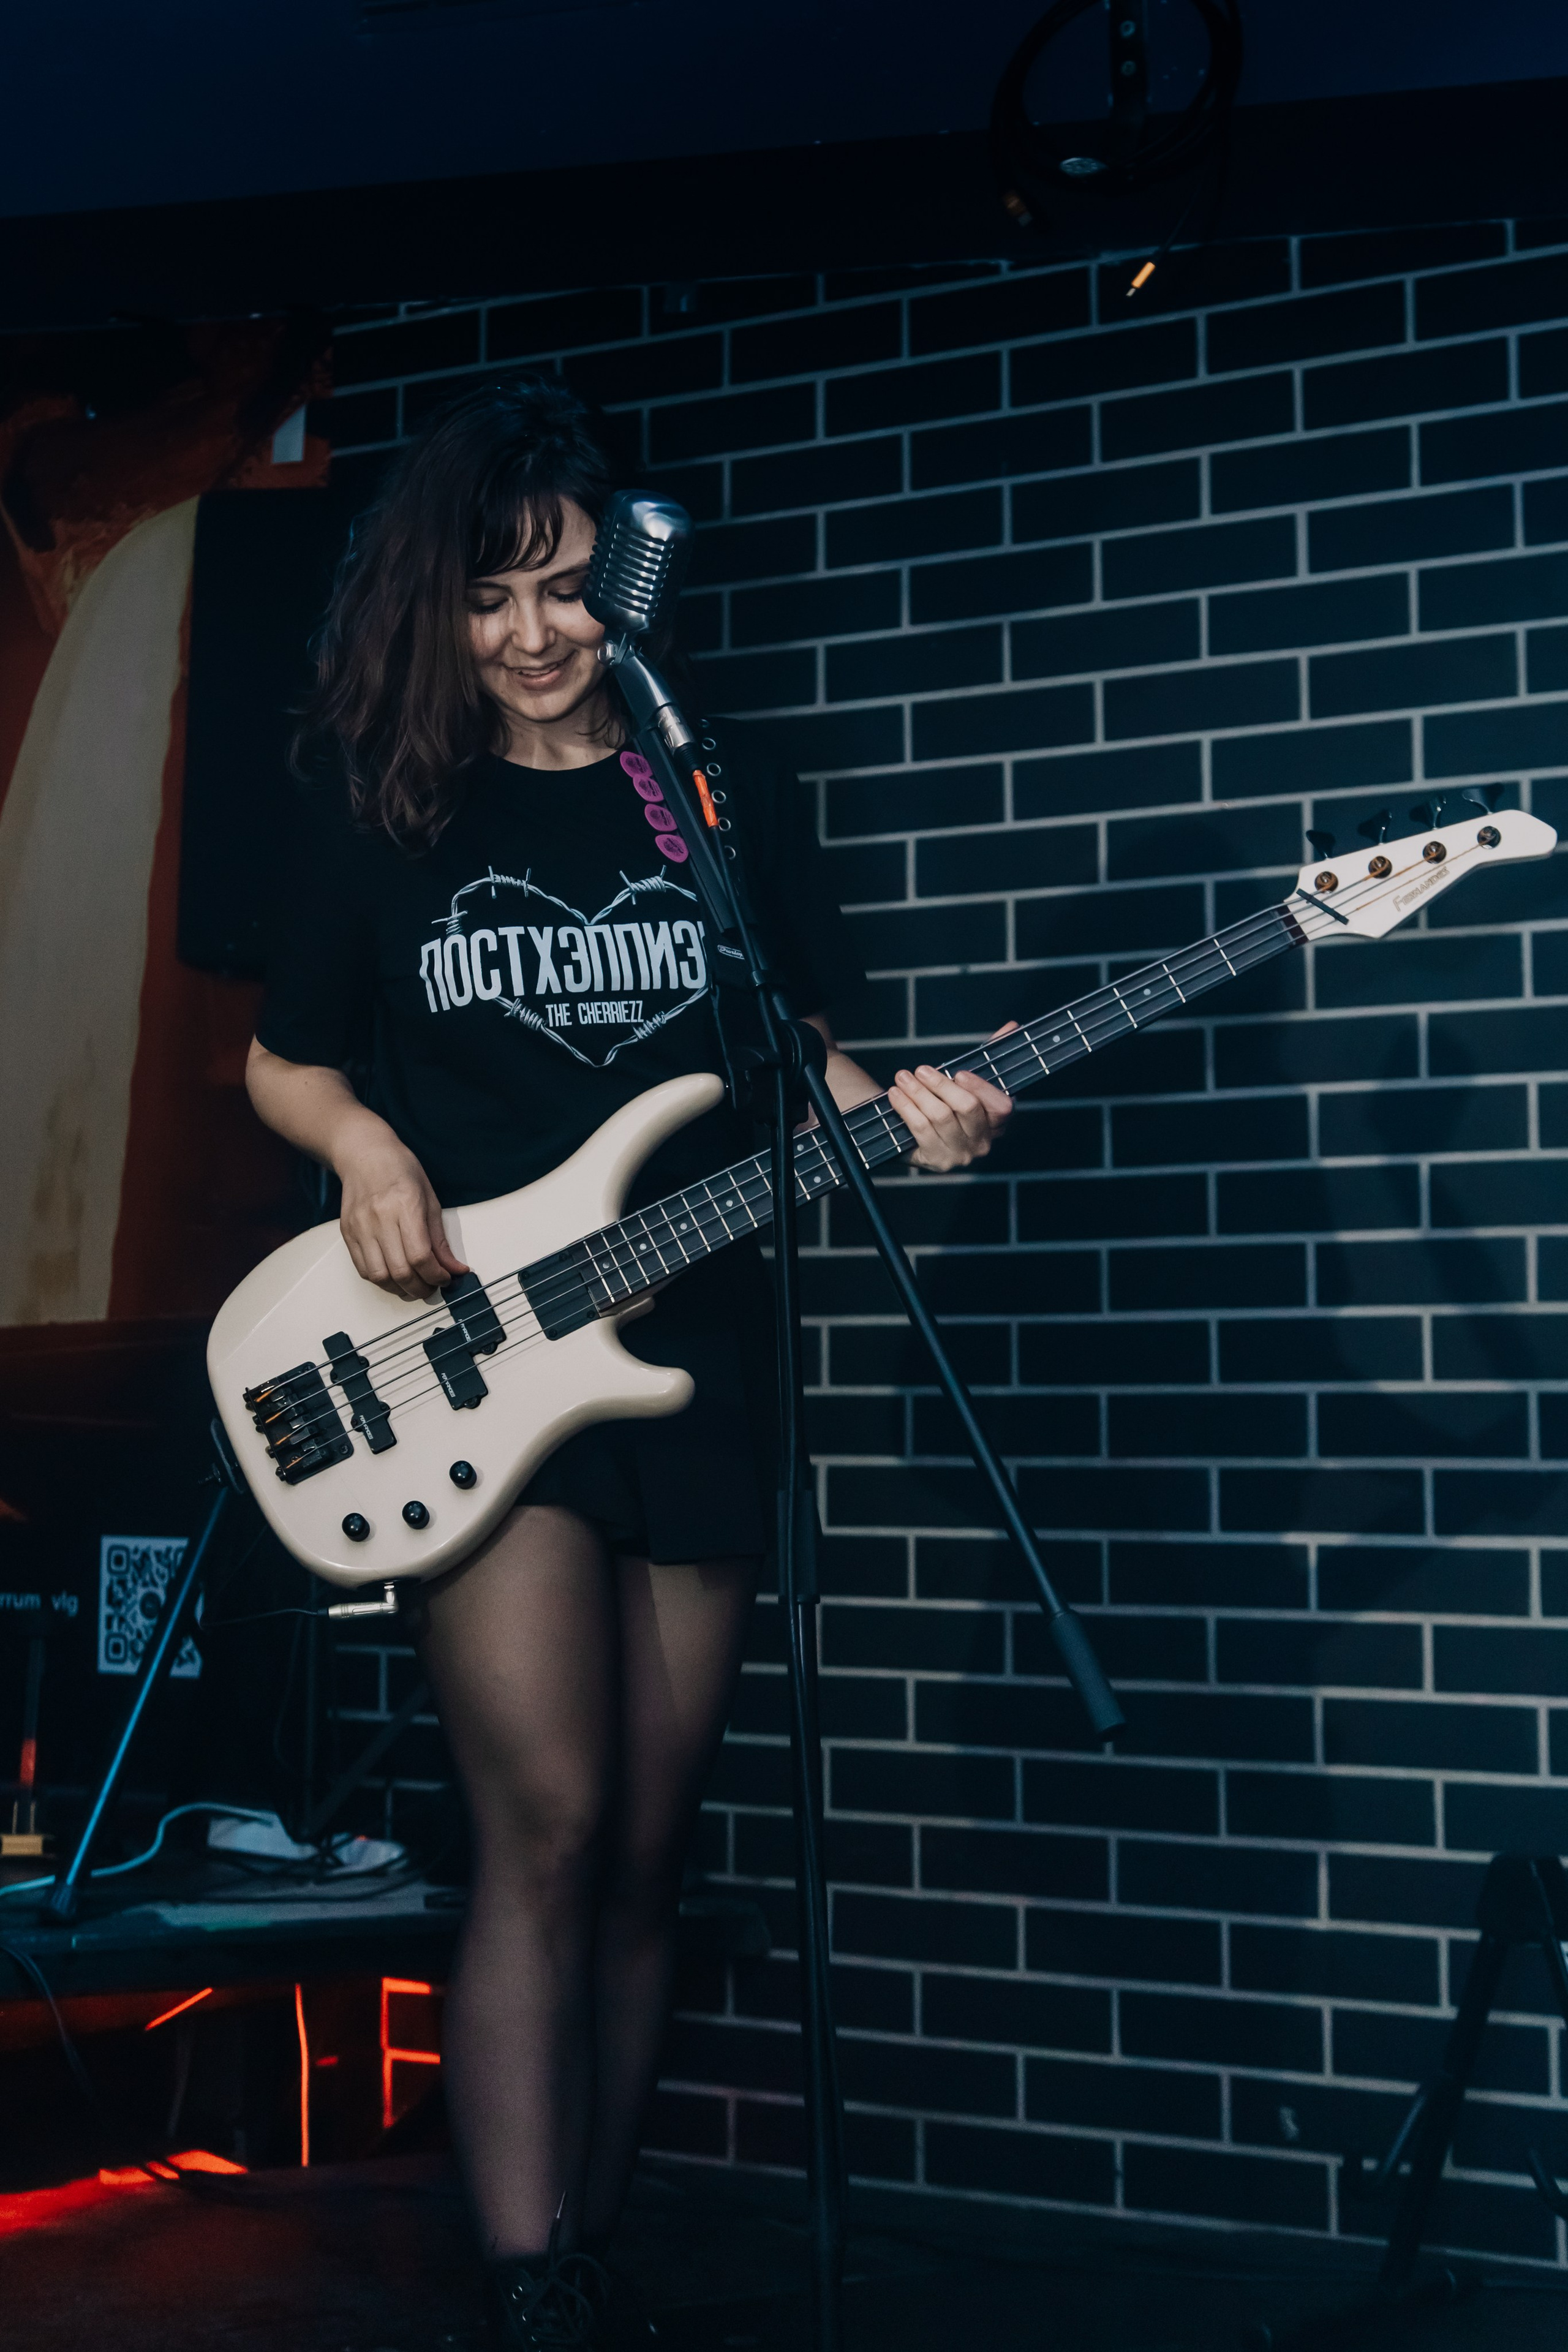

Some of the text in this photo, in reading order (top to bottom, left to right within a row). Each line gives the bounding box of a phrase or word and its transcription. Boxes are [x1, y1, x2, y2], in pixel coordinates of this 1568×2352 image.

[1392, 866, 1450, 912] FERNANDES
[546, 1000, 644, 1027] THE CHERRIEZZ
